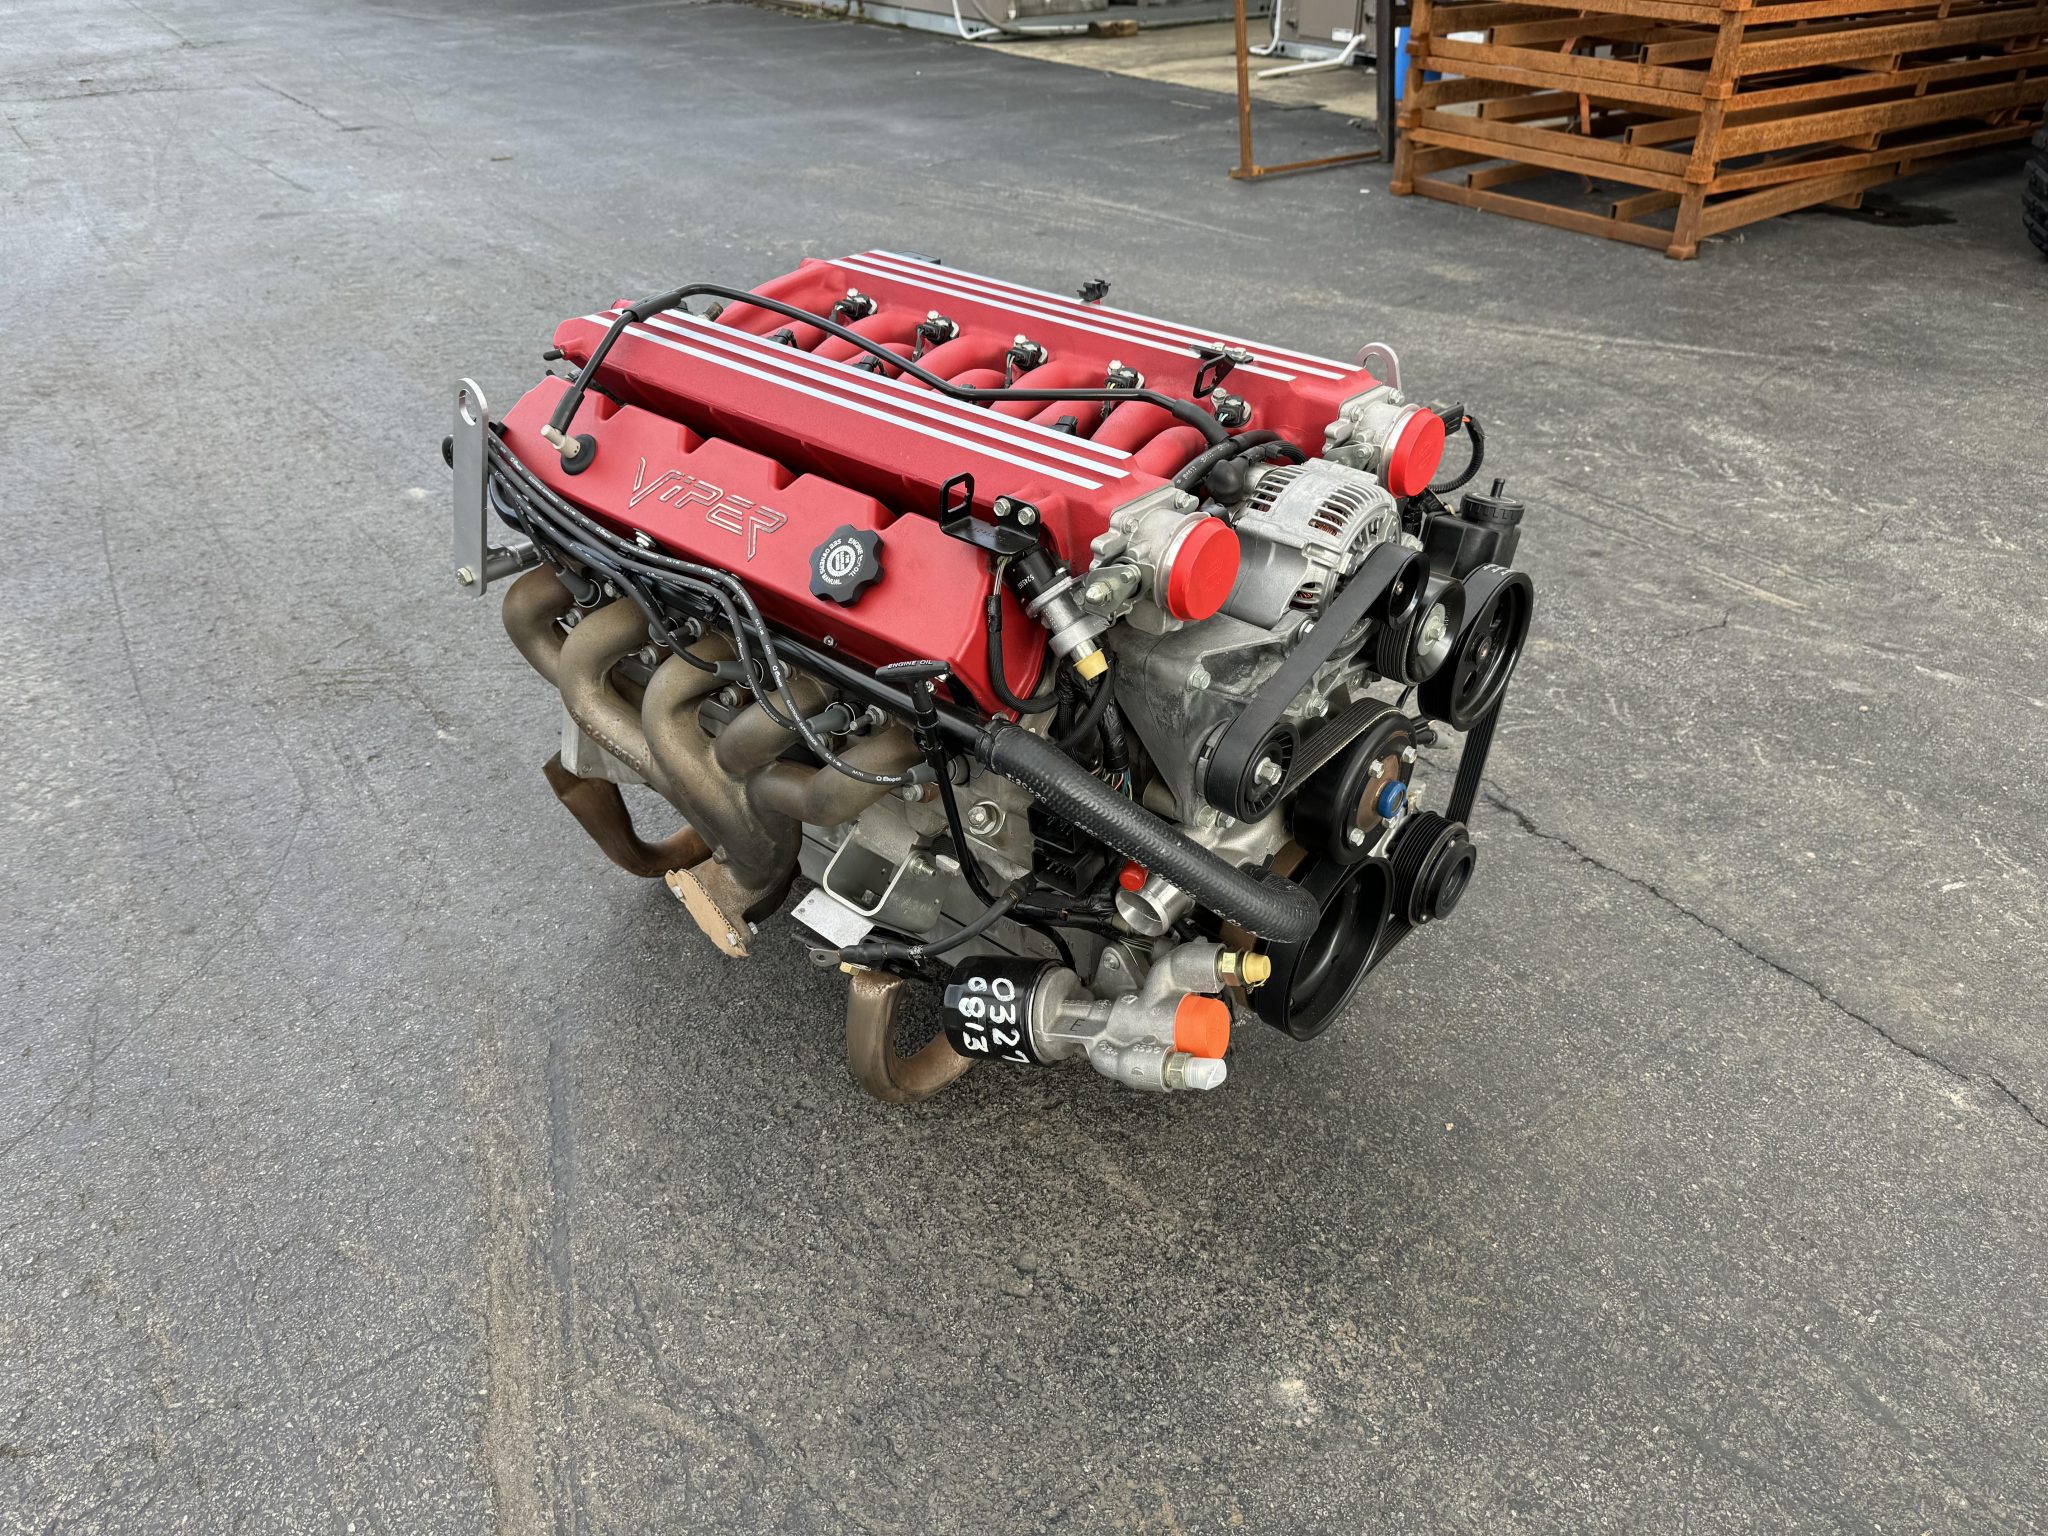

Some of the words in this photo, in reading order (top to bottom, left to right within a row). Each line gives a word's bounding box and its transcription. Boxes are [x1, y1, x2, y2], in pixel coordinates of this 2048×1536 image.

[628, 456, 788, 562] VIPER
[828, 538, 842, 550] SEE
[847, 537, 864, 555] ENGINE
[848, 566, 859, 577] OIL
[821, 572, 842, 585] MANUAL
[887, 660, 917, 669] ENGINE
